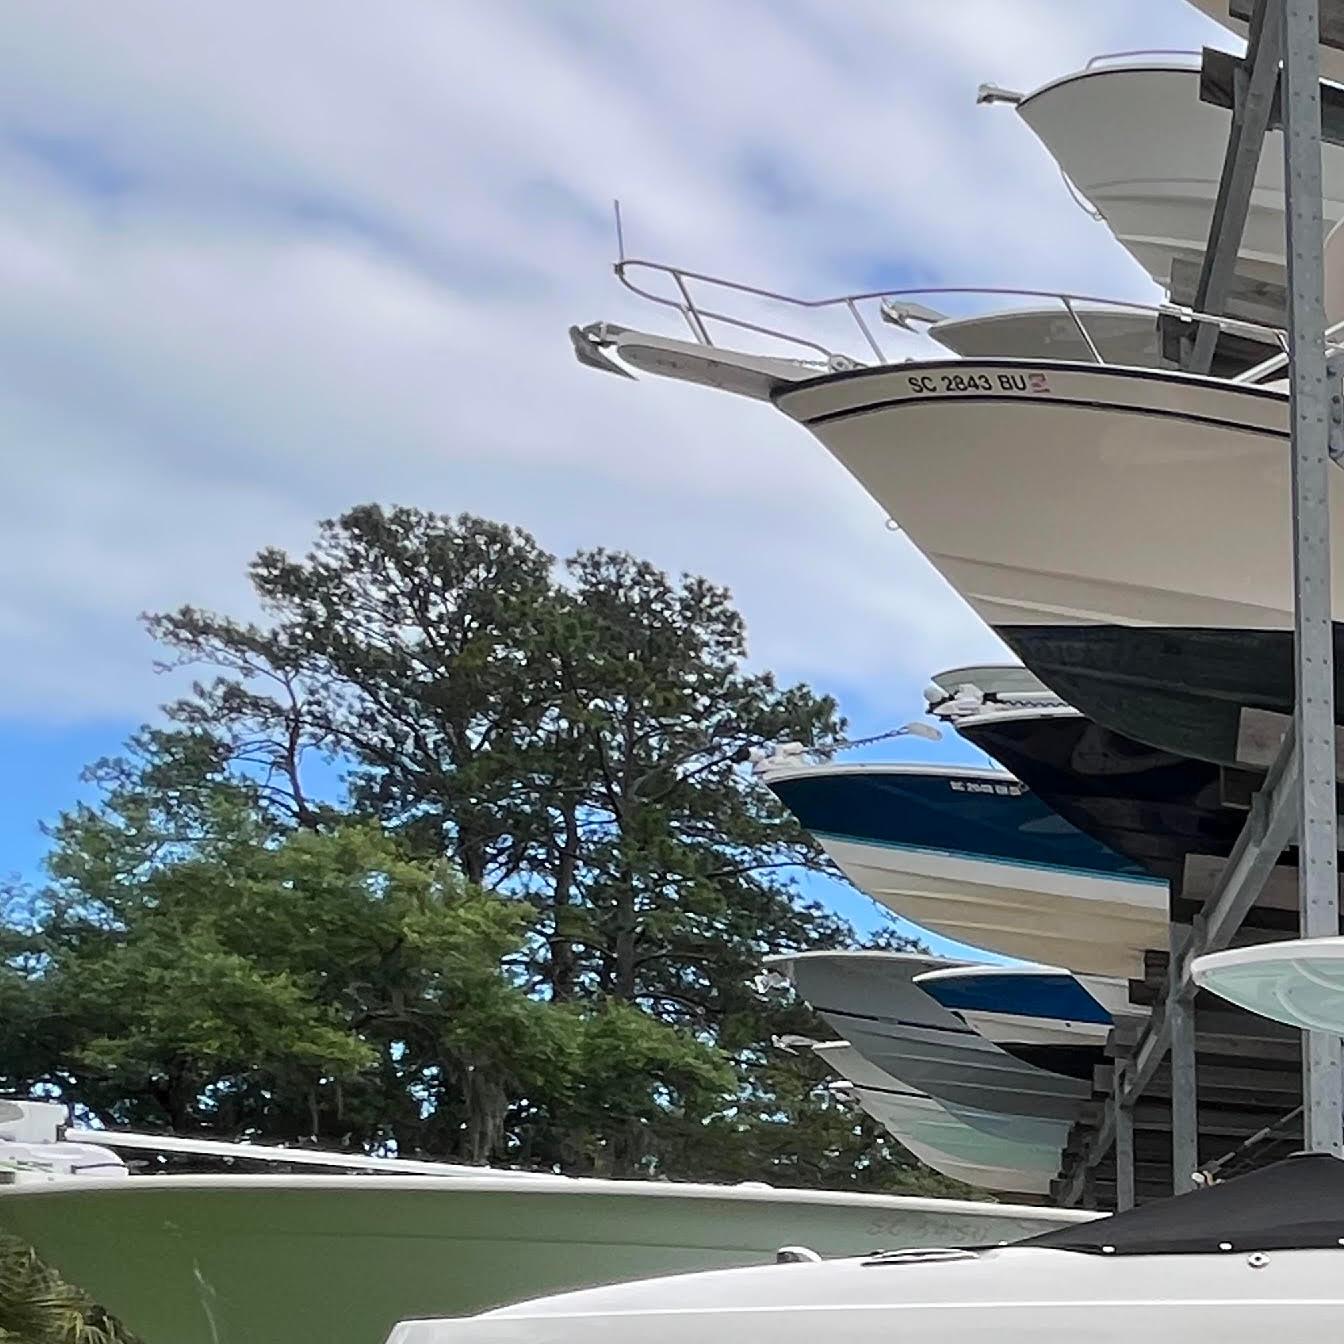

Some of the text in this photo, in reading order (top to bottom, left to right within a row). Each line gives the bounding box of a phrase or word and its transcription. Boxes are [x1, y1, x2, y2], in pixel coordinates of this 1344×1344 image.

[908, 376, 937, 393] SC
[940, 375, 992, 391] 2843
[997, 375, 1027, 391] BU
